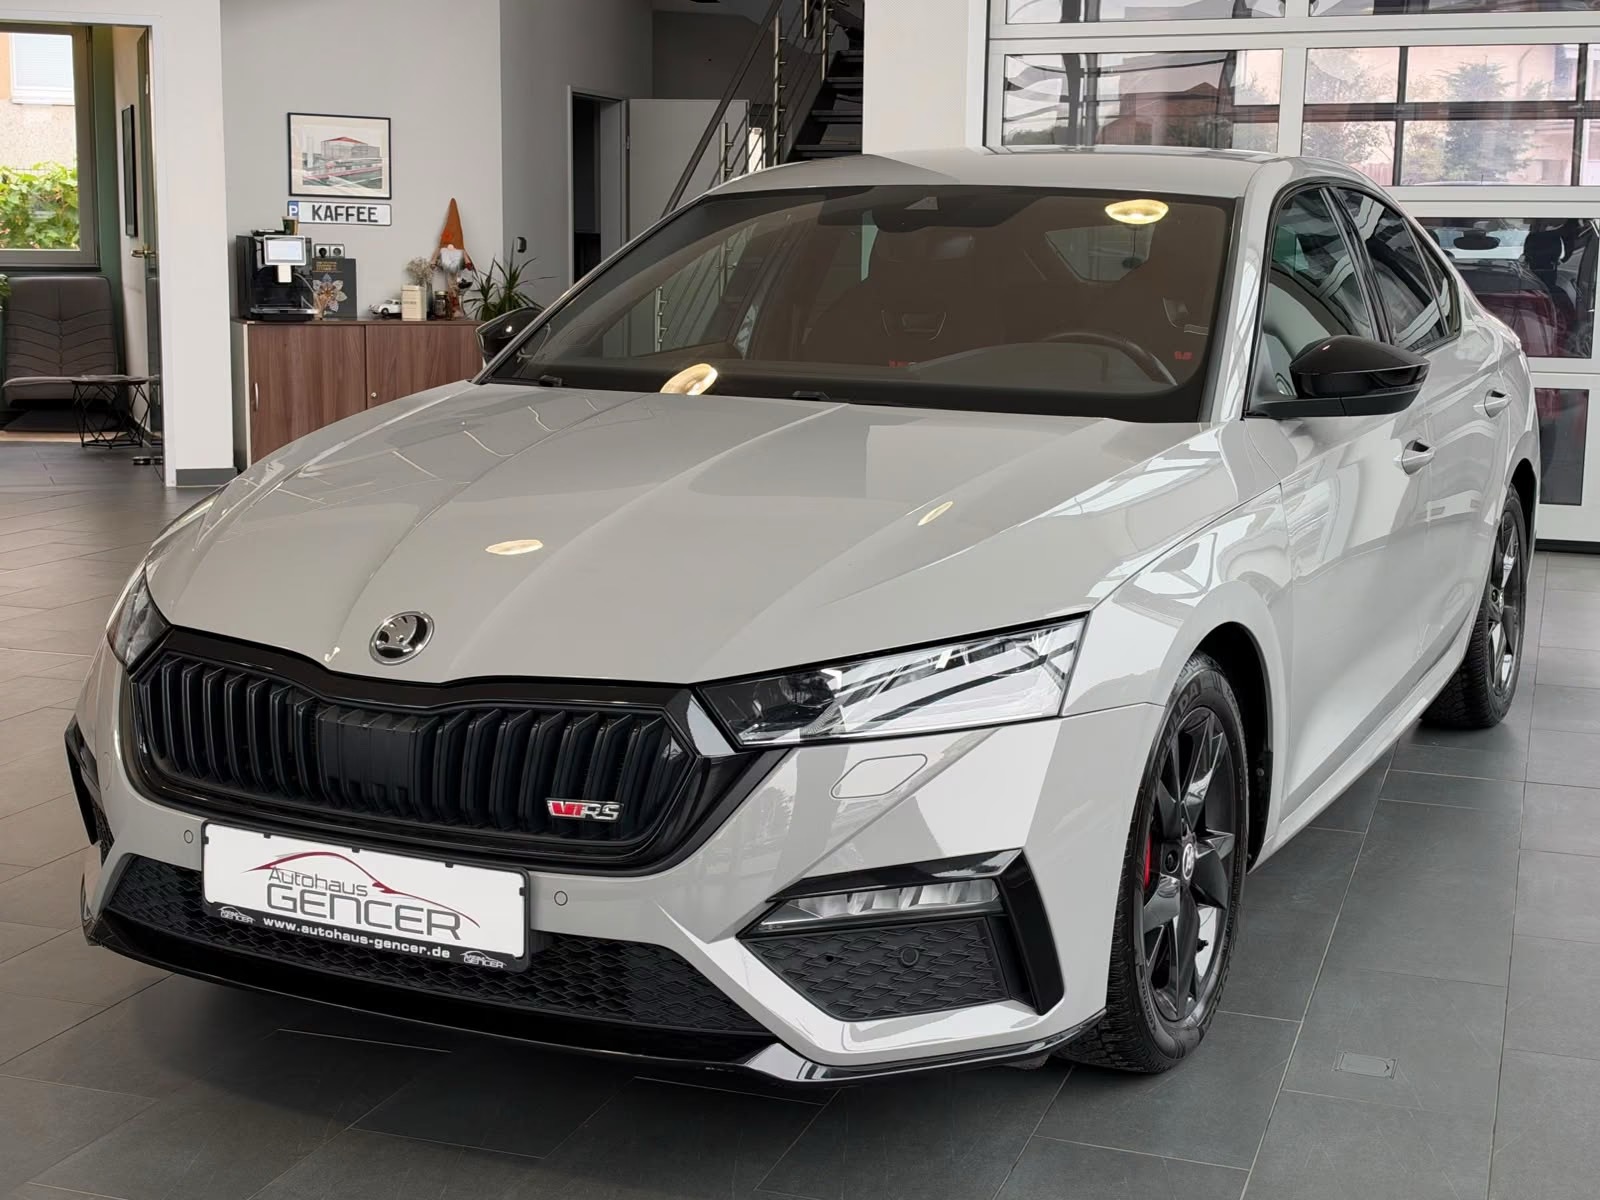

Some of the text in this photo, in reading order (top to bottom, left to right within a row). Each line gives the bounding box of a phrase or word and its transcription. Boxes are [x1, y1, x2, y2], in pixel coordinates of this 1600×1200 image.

[311, 204, 379, 223] KAFFEE
[268, 866, 368, 897] Autohaus
[266, 883, 461, 941] GENCER
[263, 917, 450, 958] www.autohaus-gencer.de
